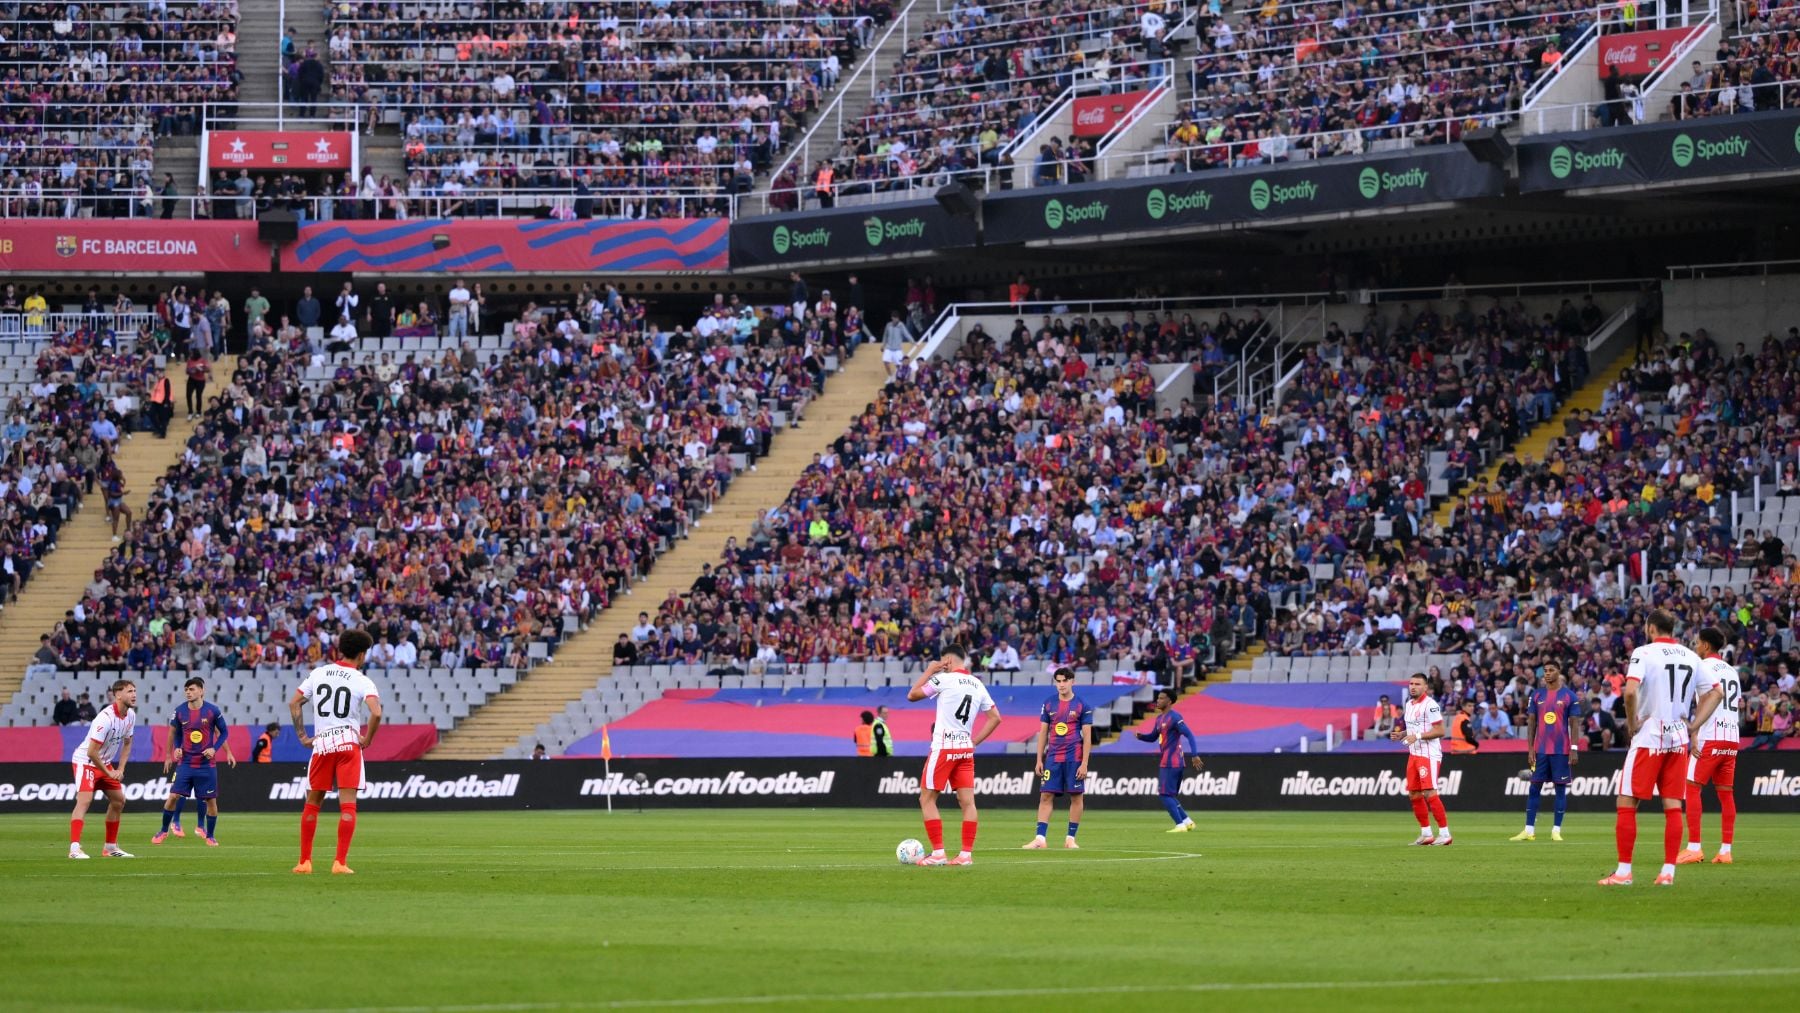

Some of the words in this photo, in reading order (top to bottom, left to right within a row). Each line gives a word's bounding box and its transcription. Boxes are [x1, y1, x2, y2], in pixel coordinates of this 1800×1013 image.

[1574, 148, 1625, 171] Spotify
[1697, 136, 1749, 160] Spotify
[1382, 168, 1428, 189] Spotify
[1169, 190, 1212, 213] Spotify
[1272, 180, 1317, 204] Spotify
[1066, 201, 1108, 223] Spotify
[792, 227, 830, 248] Spotify
[885, 218, 924, 240] Spotify
[0, 239, 13, 254] B
[82, 239, 101, 254] FC
[104, 239, 198, 255] BARCELONA
[326, 669, 352, 681] WITSEL
[1664, 663, 1693, 703] 17
[316, 683, 352, 719] 20
[1720, 678, 1738, 712] 12
[954, 694, 972, 726] 4
[580, 771, 835, 796] nike.com/football
